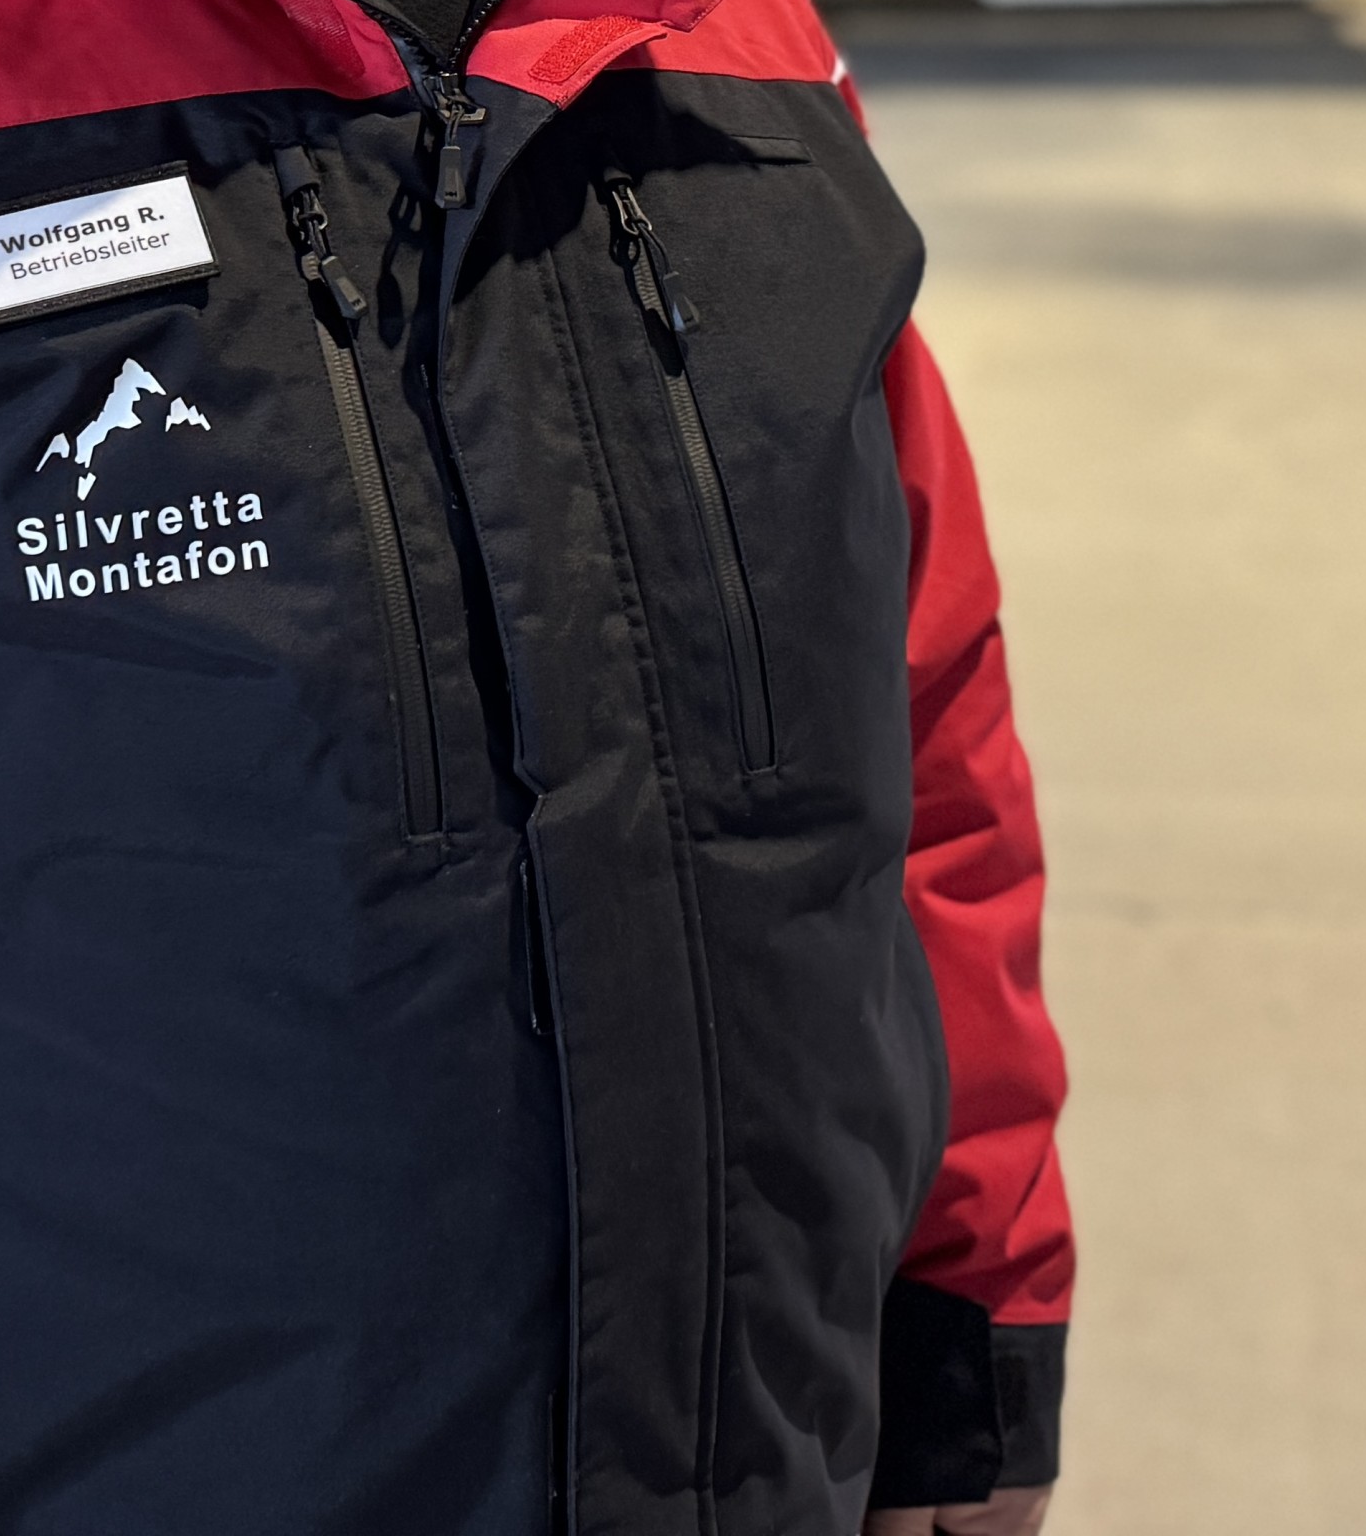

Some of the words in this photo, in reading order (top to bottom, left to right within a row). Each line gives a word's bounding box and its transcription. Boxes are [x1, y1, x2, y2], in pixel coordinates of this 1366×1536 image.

[0, 212, 130, 255] Wolfgang
[138, 205, 165, 224] R.
[10, 230, 171, 281] Betriebsleiter
[16, 491, 263, 556] Silvretta
[25, 539, 270, 602] Montafon
